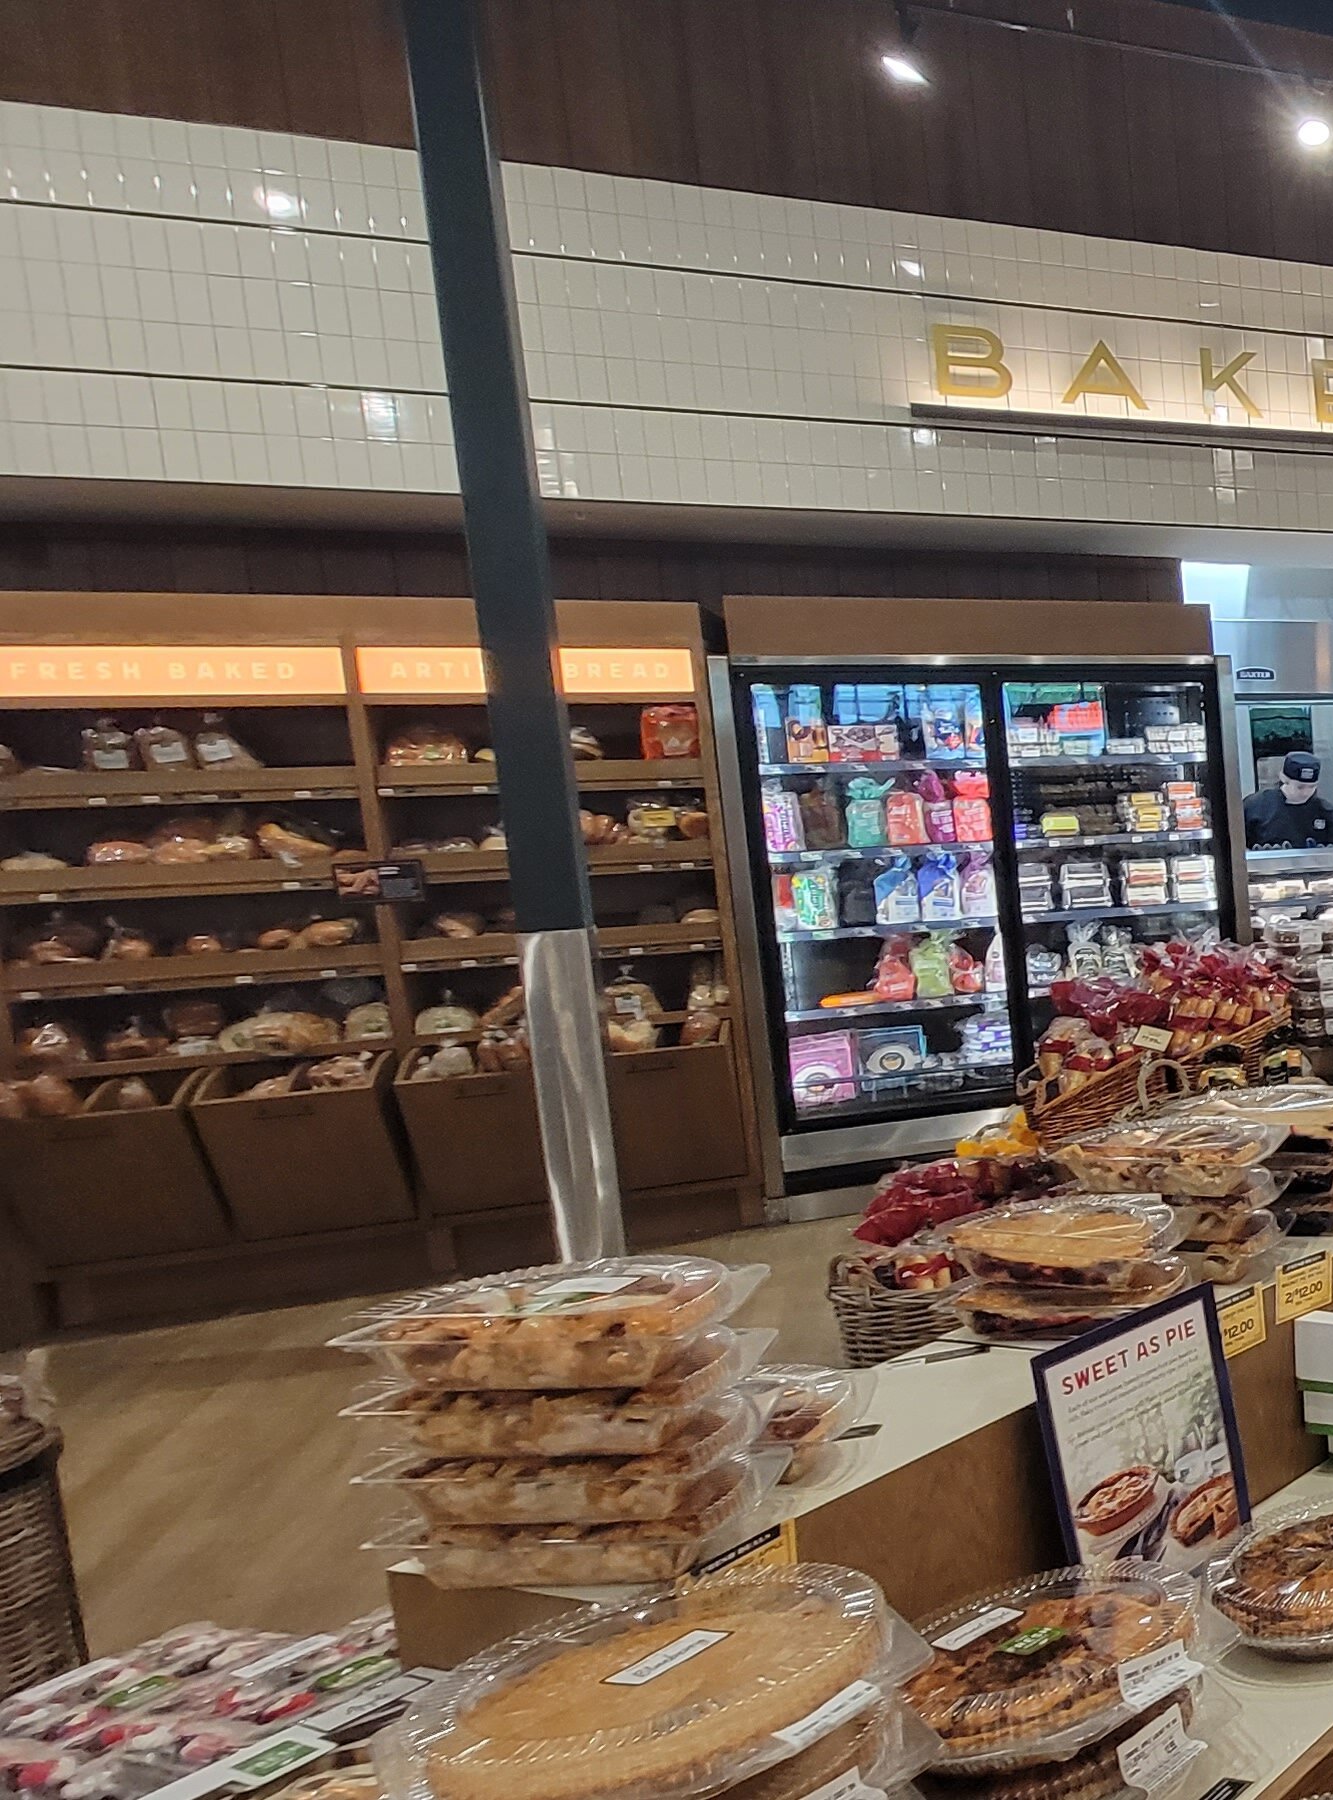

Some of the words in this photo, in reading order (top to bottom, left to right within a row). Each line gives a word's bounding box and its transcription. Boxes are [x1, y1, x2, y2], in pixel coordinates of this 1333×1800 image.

[10, 662, 141, 680] FRESH
[168, 662, 295, 680] BAKED
[566, 662, 670, 679] BREAD
[1285, 1281, 1323, 1304] 2/$12.00
[1062, 1349, 1129, 1395] SWEET
[1137, 1336, 1161, 1361] AS
[1165, 1318, 1197, 1347] PIE
